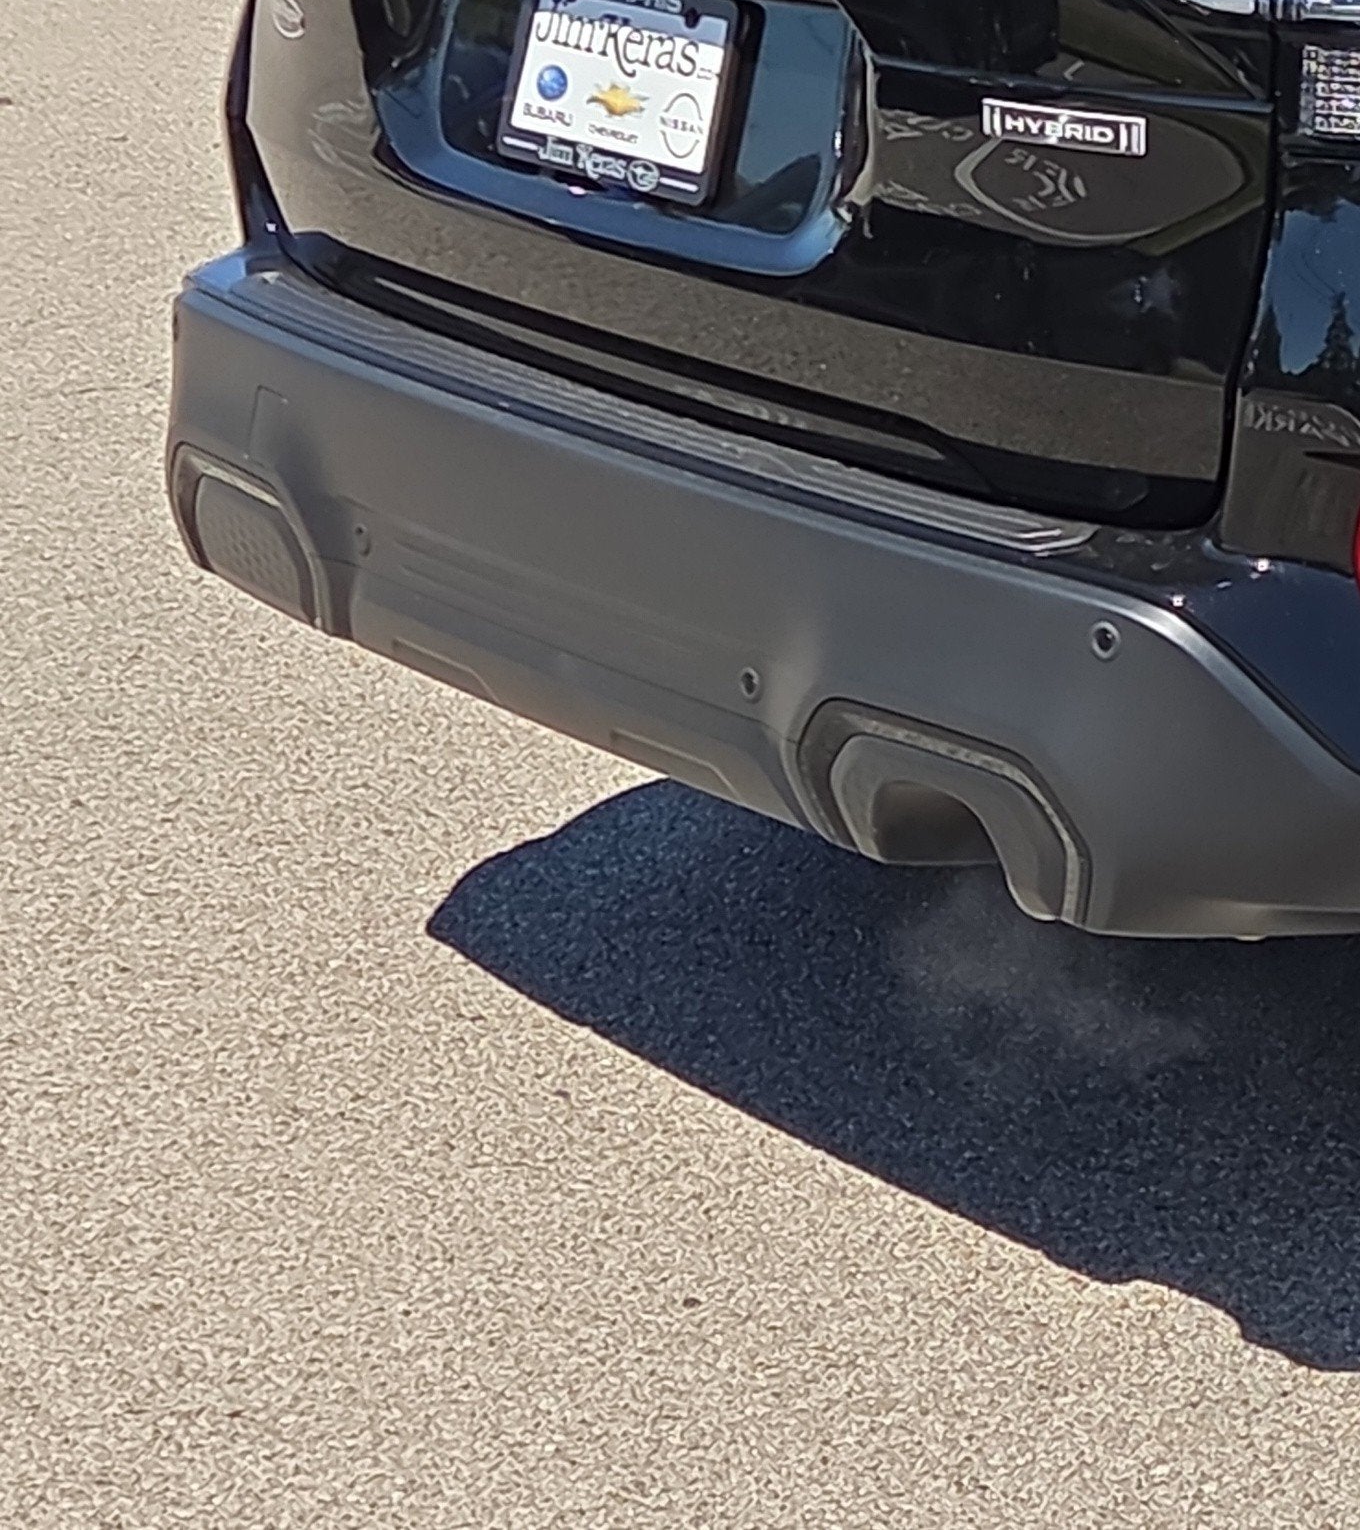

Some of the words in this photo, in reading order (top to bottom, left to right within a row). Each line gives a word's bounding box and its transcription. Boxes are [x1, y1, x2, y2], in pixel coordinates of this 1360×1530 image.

[597, 18, 700, 78] Keras
[660, 114, 704, 135] NISSAN
[1004, 113, 1115, 143] HYBRID
[537, 136, 574, 166] Jim
[576, 143, 628, 180] Keras
